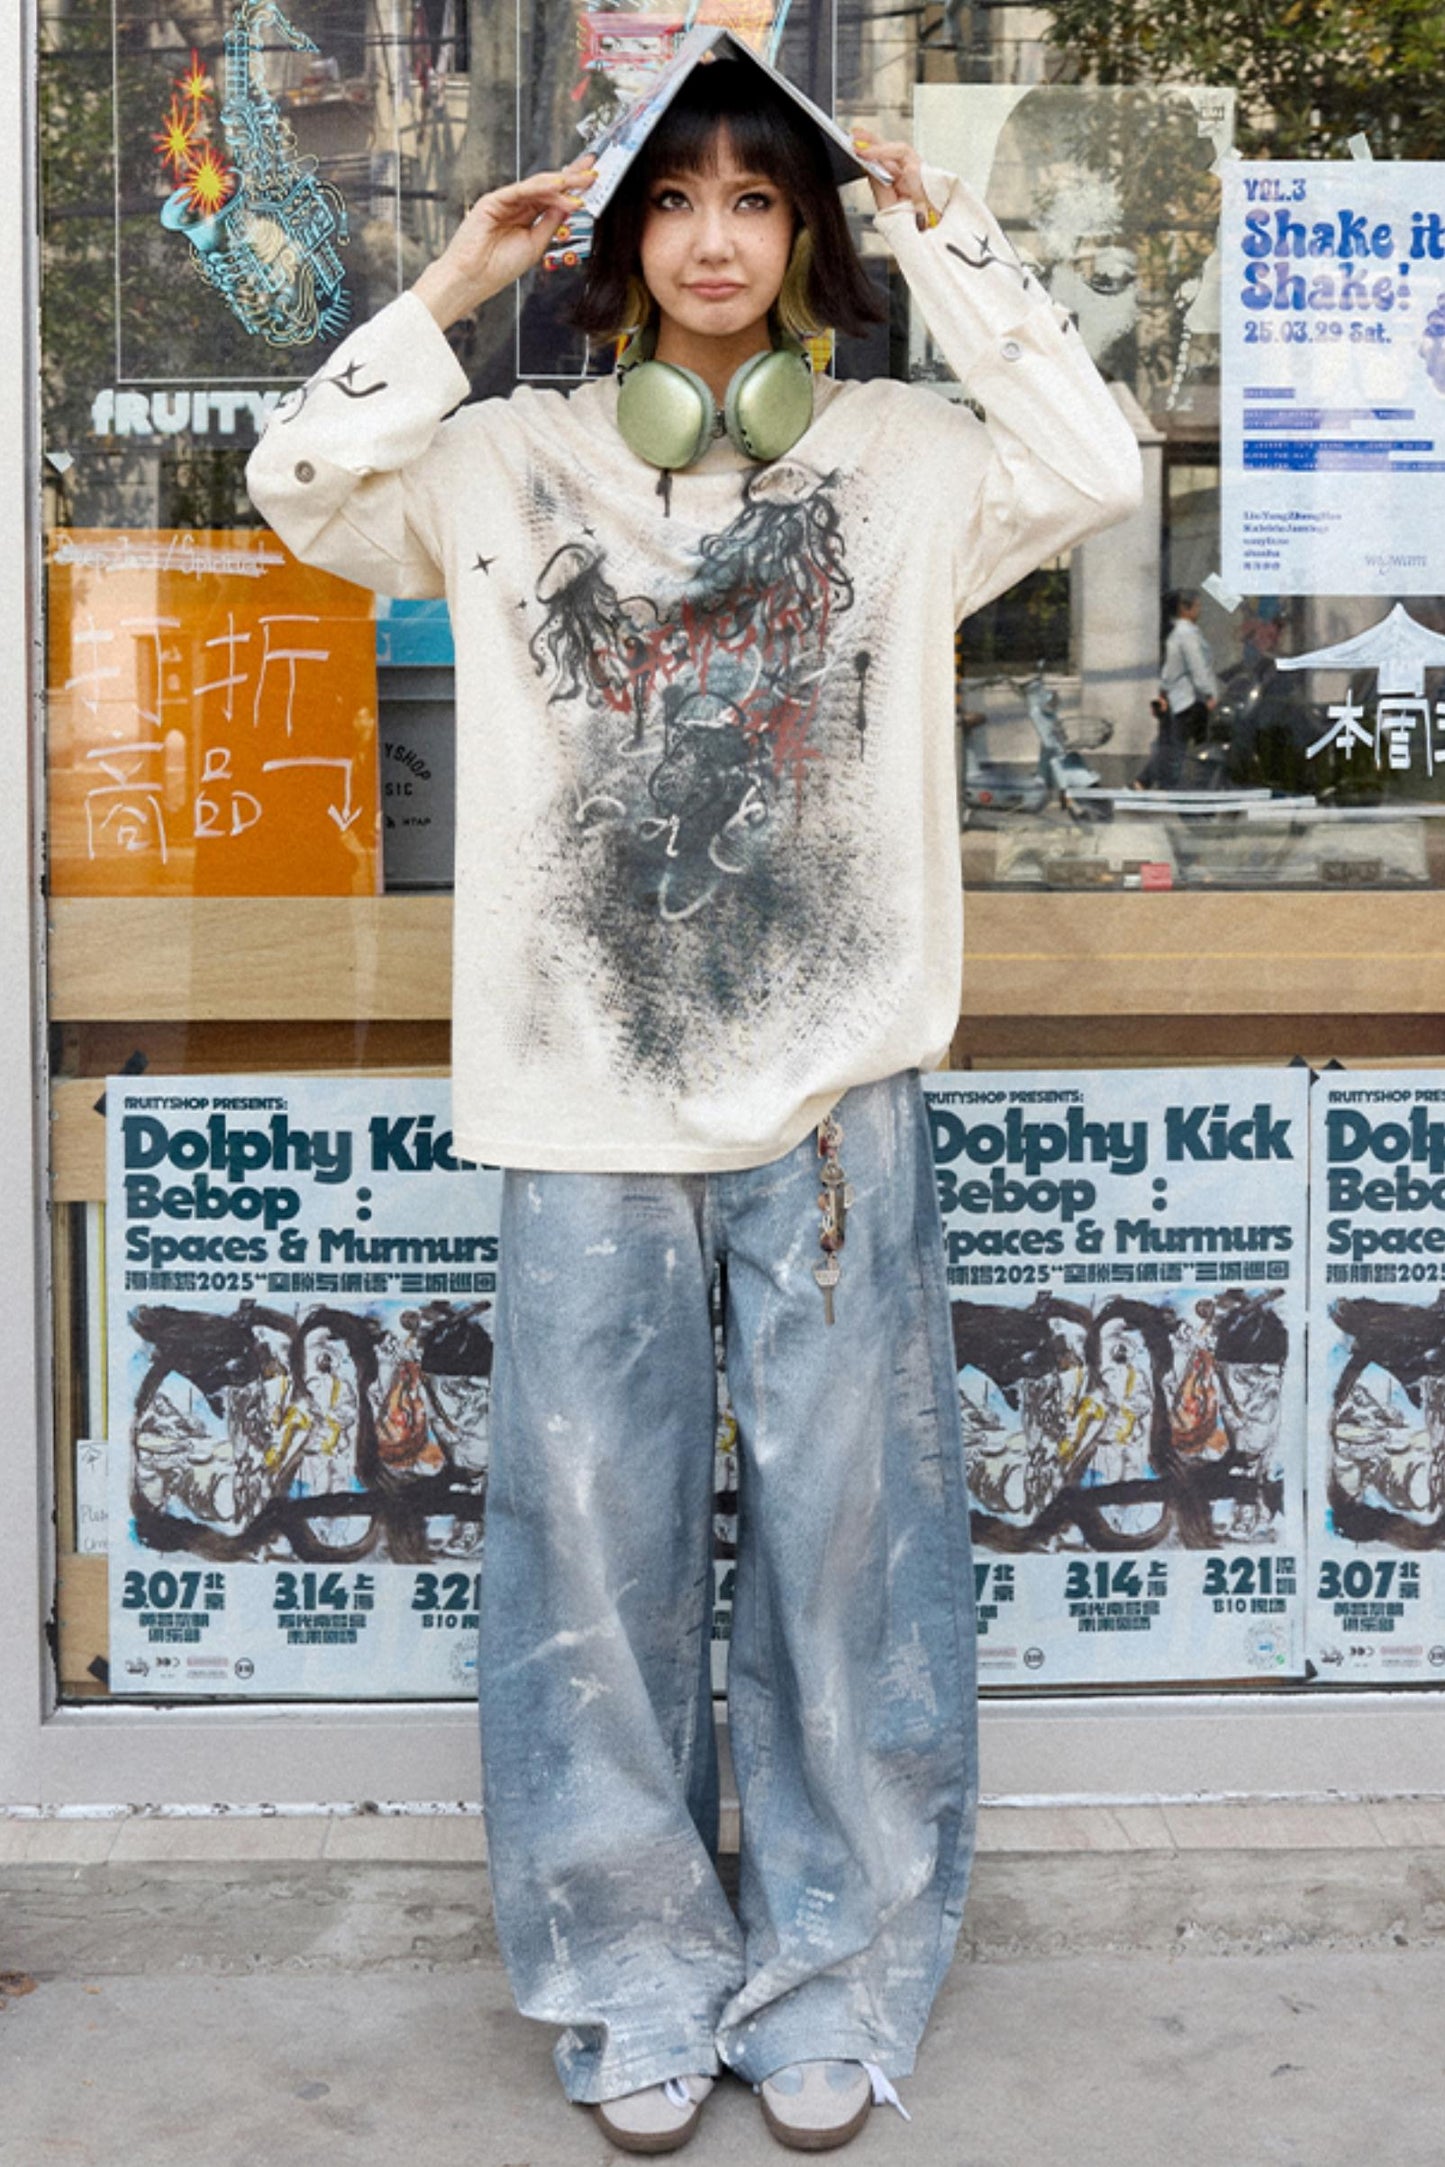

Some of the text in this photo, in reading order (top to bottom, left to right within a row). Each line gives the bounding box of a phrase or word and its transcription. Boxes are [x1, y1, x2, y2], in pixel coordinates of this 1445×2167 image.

[1241, 208, 1445, 259] Shake it
[1241, 261, 1412, 311] Shake!
[1243, 320, 1392, 343] 25.03.29 Sat.
[212, 1096, 288, 1111] PRESENTS:
[1009, 1088, 1084, 1104] PRESENTS:
[121, 1115, 353, 1184] Dolphy
[928, 1104, 1294, 1175] Dolphy Kick
[123, 1173, 300, 1230] Bebop
[125, 1226, 500, 1268] Spaces & Murmurs
[942, 1219, 1294, 1262] paces & Murmurs
